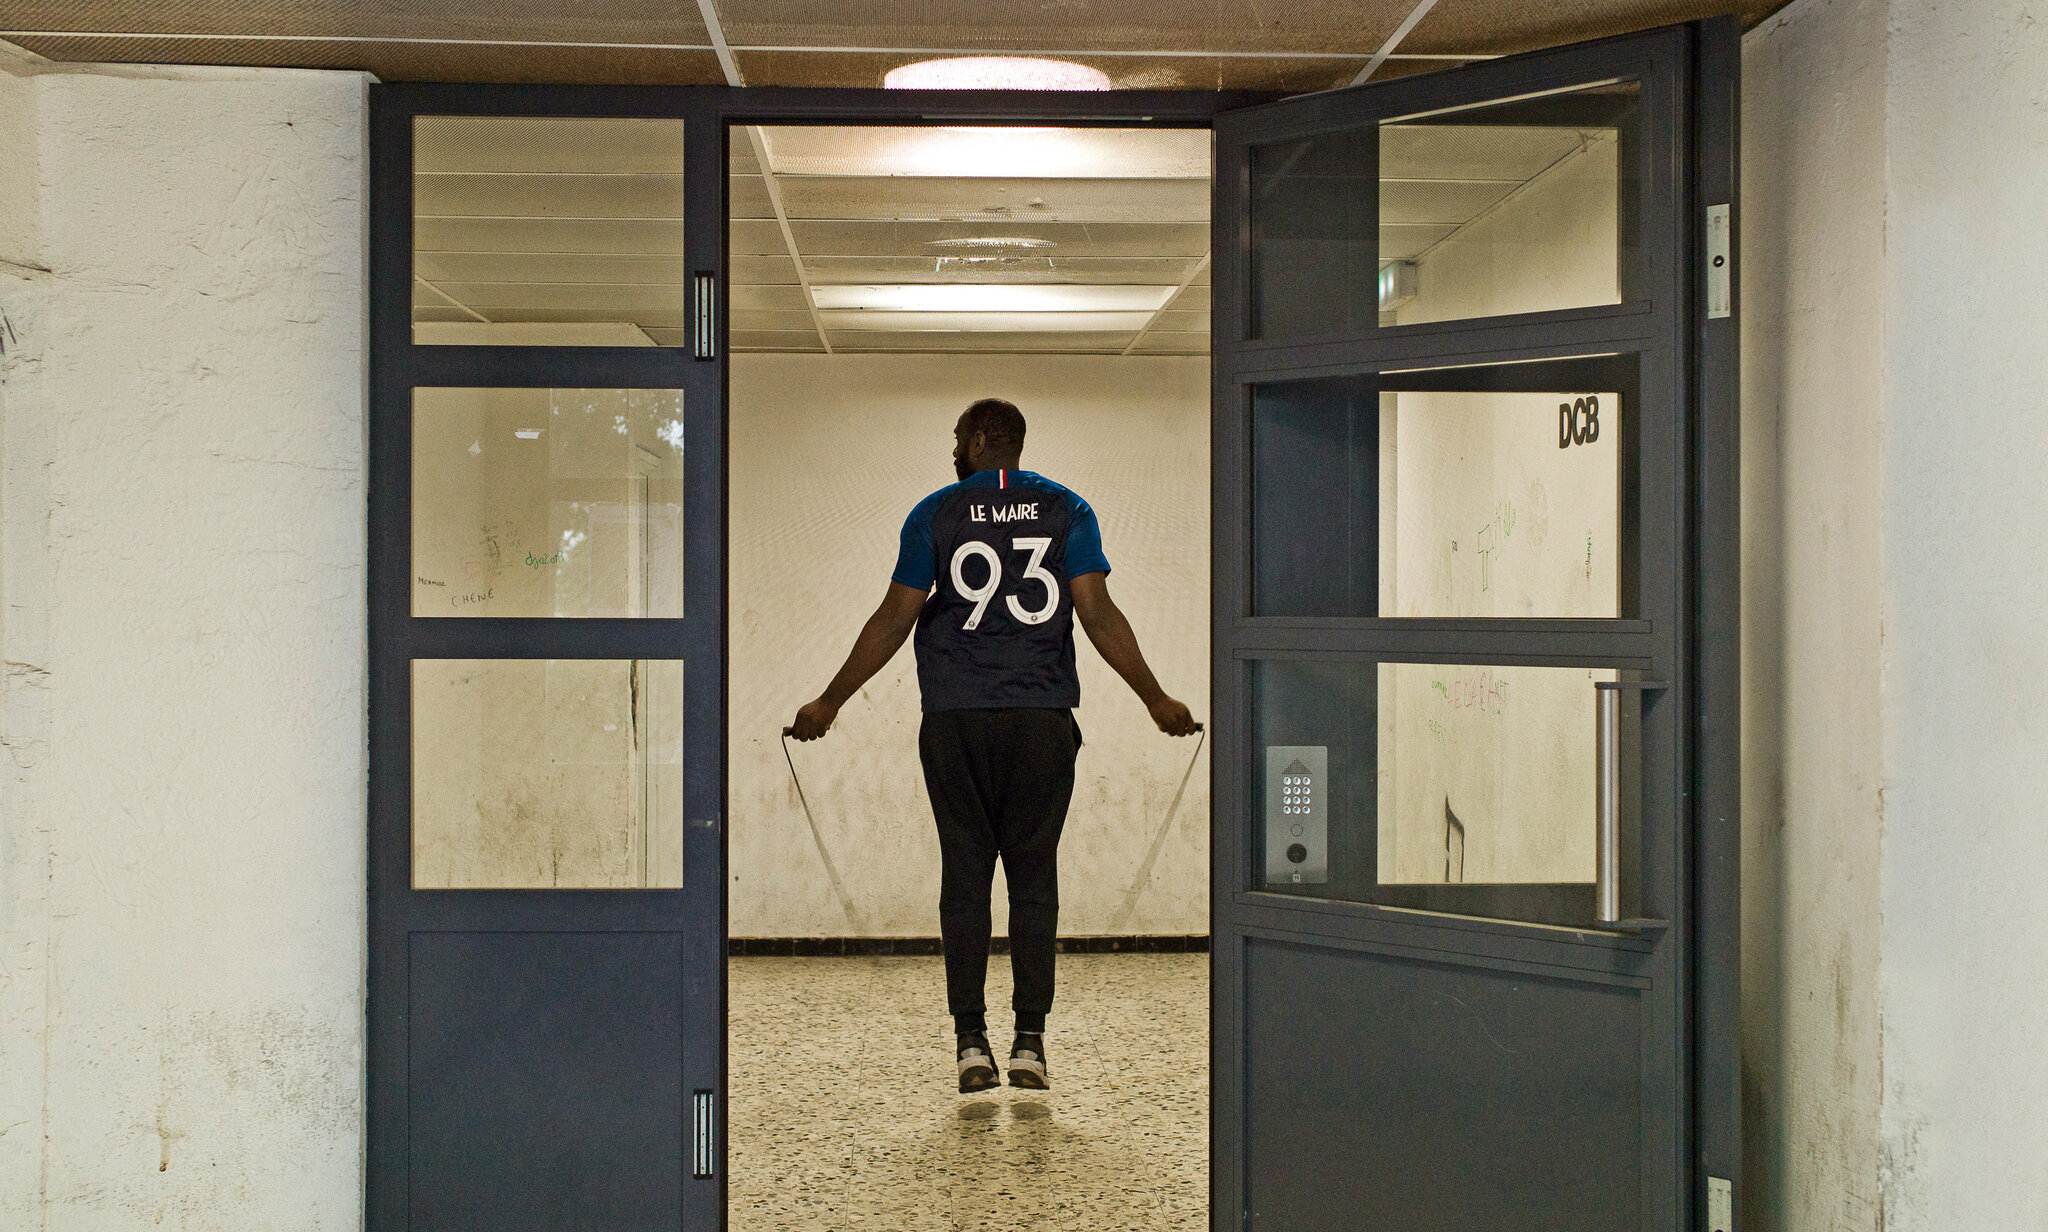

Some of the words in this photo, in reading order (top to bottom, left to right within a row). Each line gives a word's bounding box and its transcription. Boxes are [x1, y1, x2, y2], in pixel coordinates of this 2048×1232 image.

[1559, 395, 1599, 449] DCB
[970, 504, 987, 522] LE
[992, 502, 1039, 523] MAIRE
[950, 537, 1060, 631] 93
